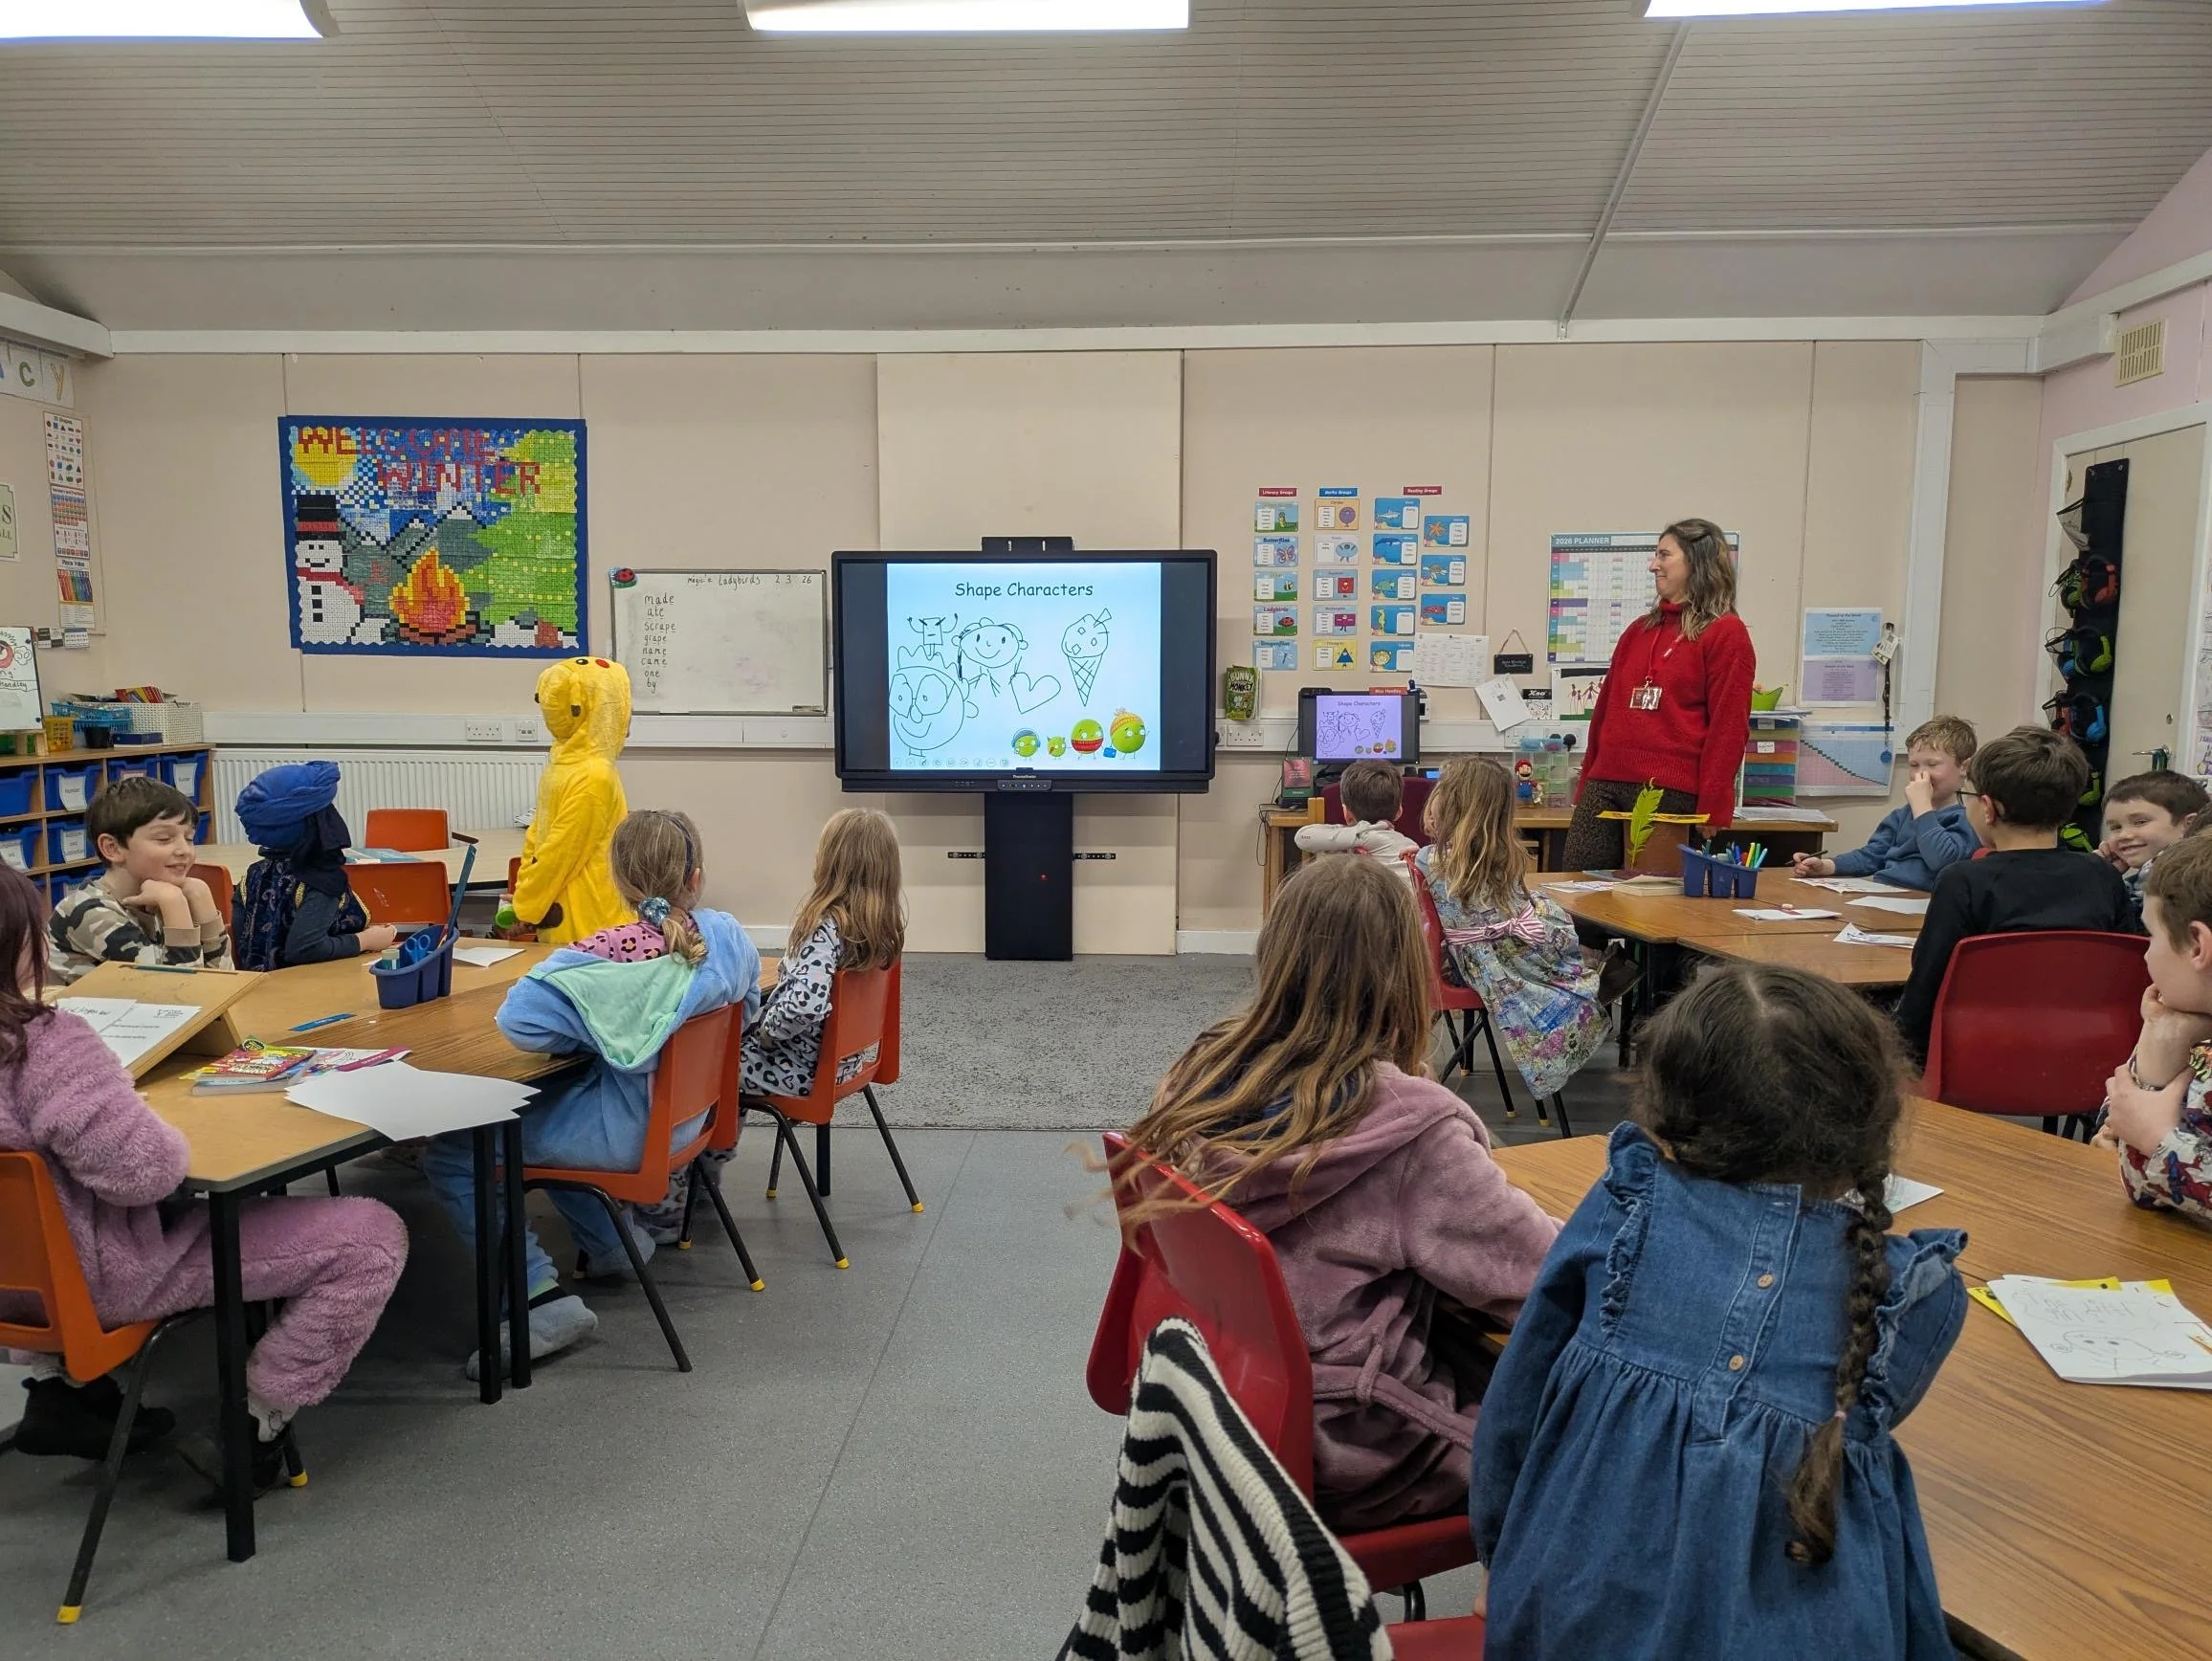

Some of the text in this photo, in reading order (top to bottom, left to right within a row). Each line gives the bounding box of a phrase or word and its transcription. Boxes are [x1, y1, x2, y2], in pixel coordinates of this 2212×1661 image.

[298, 427, 494, 455] WELCOME
[377, 458, 541, 495] WINTER
[785, 575, 792, 584] 3
[802, 575, 812, 584] 26
[955, 582, 1094, 601] Shape Characters
[644, 592, 674, 605] made
[647, 606, 664, 617] ate
[644, 622, 675, 633] scrape
[644, 635, 667, 646] grape
[1230, 672, 1253, 682] BUNNY
[647, 677, 656, 694] by
[1230, 682, 1253, 692] MONKEY
